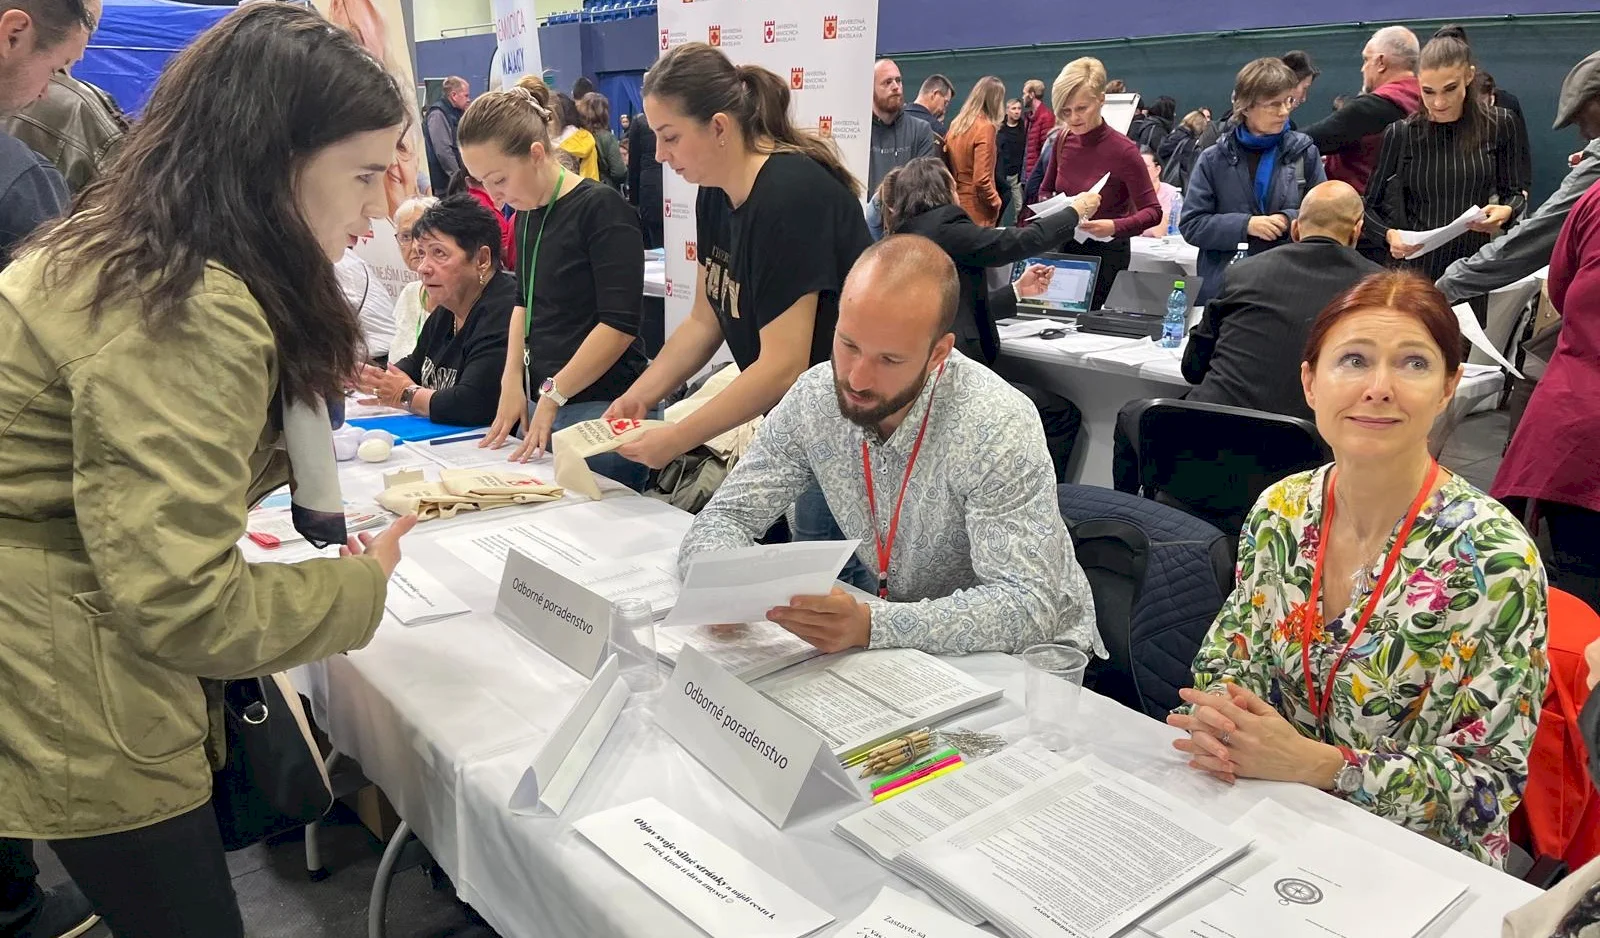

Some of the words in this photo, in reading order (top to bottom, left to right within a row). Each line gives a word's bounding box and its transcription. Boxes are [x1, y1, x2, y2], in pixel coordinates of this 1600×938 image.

[512, 577, 544, 606] Odborné
[543, 599, 594, 635] poradenstvo
[684, 681, 725, 721] Odborné
[721, 714, 788, 770] poradenstvo
[633, 818, 657, 836] Objav
[654, 835, 676, 850] svoje
[674, 850, 698, 864] silné
[694, 864, 728, 886] stránky
[883, 915, 917, 934] Zastavte
